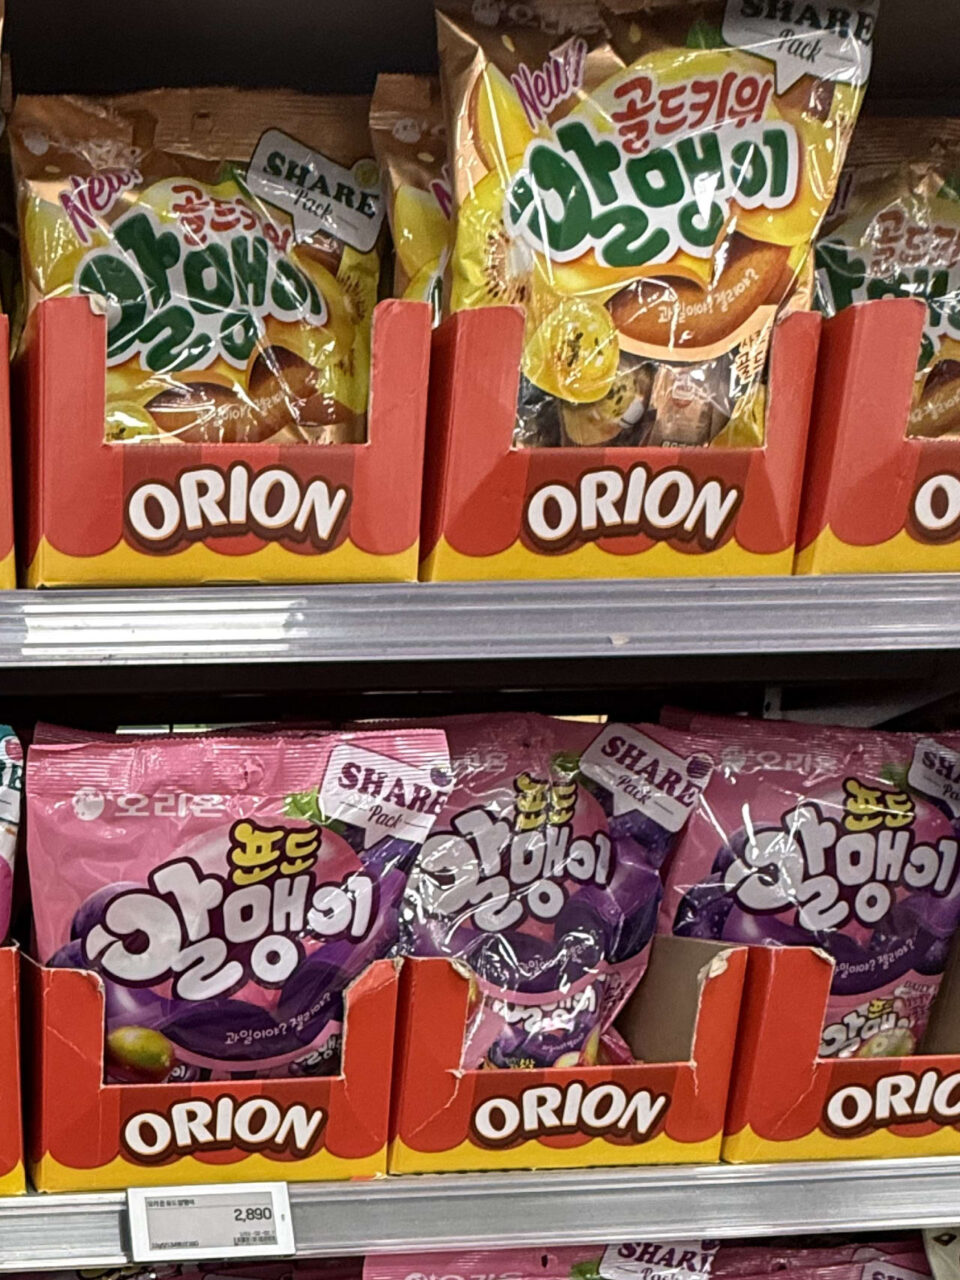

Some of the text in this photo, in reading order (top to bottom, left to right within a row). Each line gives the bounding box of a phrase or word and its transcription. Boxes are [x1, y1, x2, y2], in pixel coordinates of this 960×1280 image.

[740, 0, 874, 44] SHARE
[776, 28, 822, 64] Pack
[512, 38, 588, 129] New!
[611, 72, 772, 153] 골드키위
[263, 150, 380, 220] SHARE
[293, 187, 334, 222] Pack
[510, 121, 789, 268] 알맹이
[78, 211, 323, 372] 알맹이
[127, 466, 348, 542] ORION
[527, 466, 740, 542] ORION
[338, 761, 449, 816] SHARE
[601, 736, 705, 806] SHARE
[617, 774, 653, 804] Pack
[114, 792, 225, 819] 오리온
[367, 805, 405, 828] Pack
[843, 778, 916, 832] 포도
[231, 822, 321, 885] 포도
[413, 805, 611, 932] 알맹이
[726, 807, 959, 931] 알맹이
[85, 861, 373, 1002] 알맹이
[834, 938, 915, 979] 일이야? 젤리야?
[225, 992, 333, 1047] 과일이야? 젤리야?
[124, 1097, 326, 1157] ORION
[474, 1084, 667, 1142] ORION
[233, 1207, 272, 1223] 2,890
